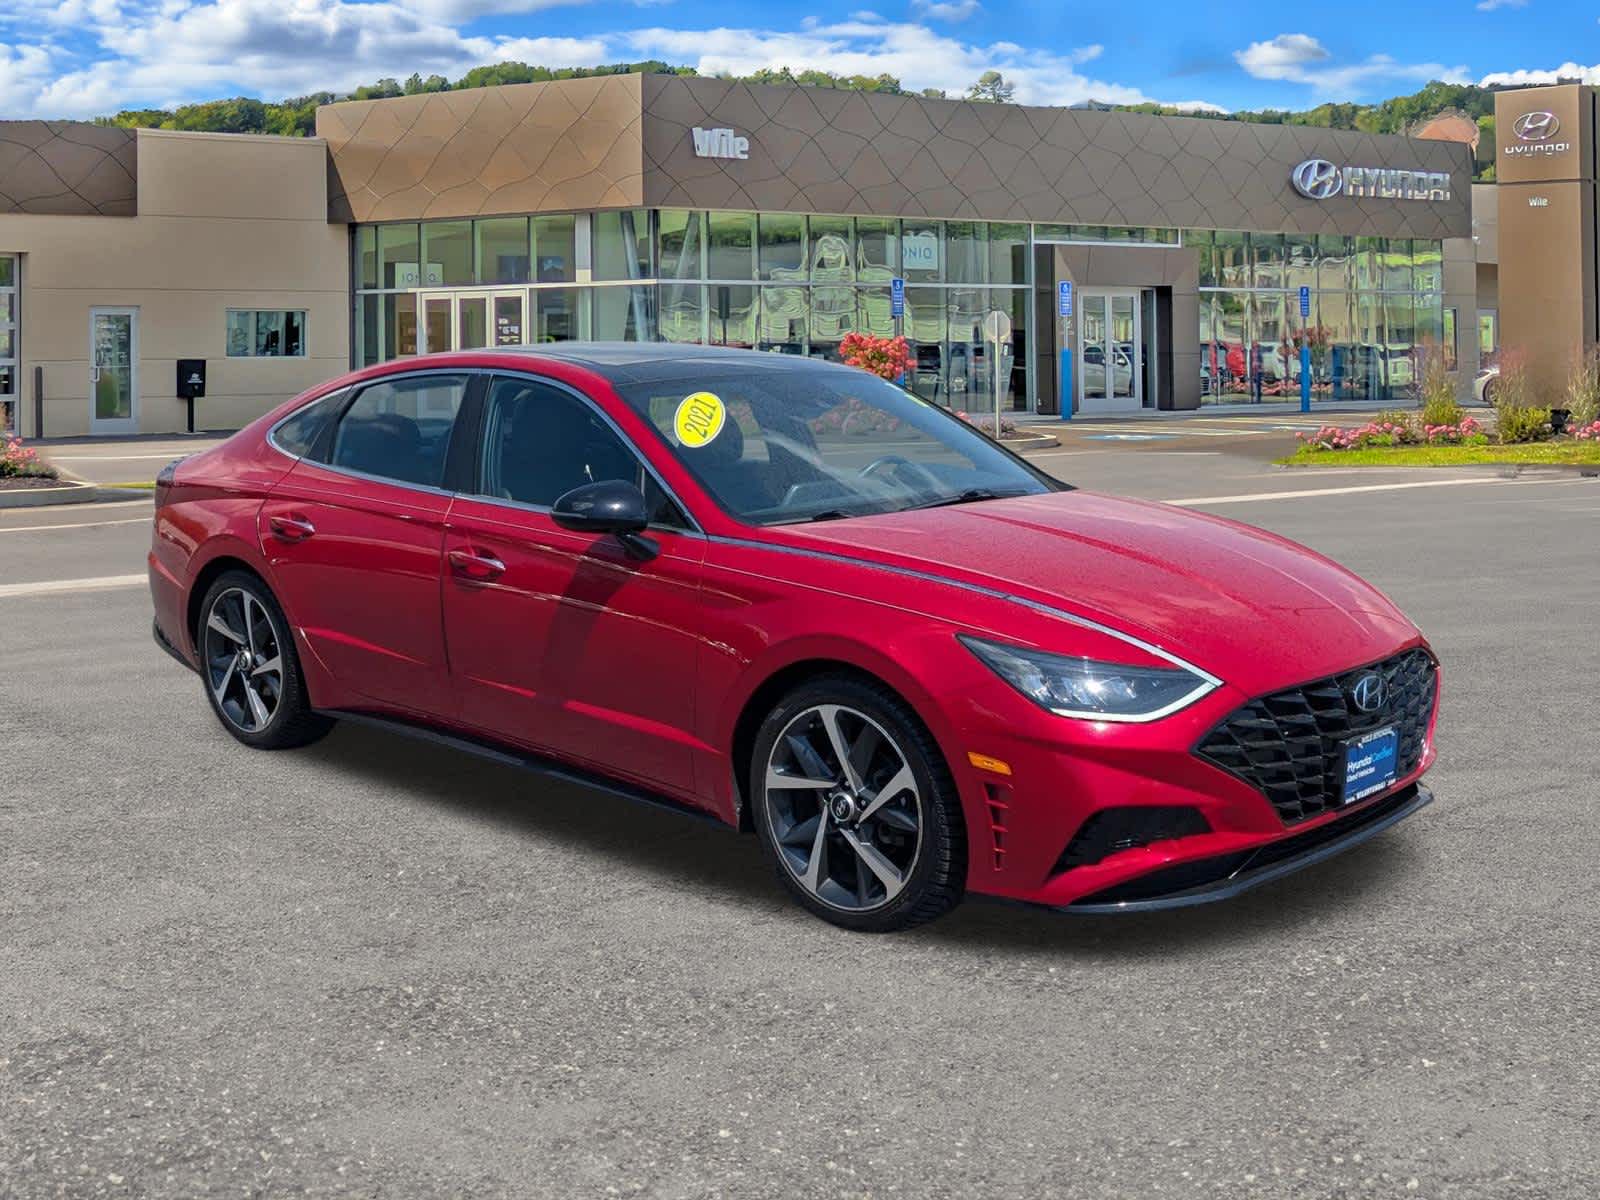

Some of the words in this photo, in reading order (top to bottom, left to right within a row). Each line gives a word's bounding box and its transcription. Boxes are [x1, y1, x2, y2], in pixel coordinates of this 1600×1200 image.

[692, 126, 750, 160] Wile
[1343, 167, 1450, 201] HYUNDAI
[683, 398, 717, 439] 2021
